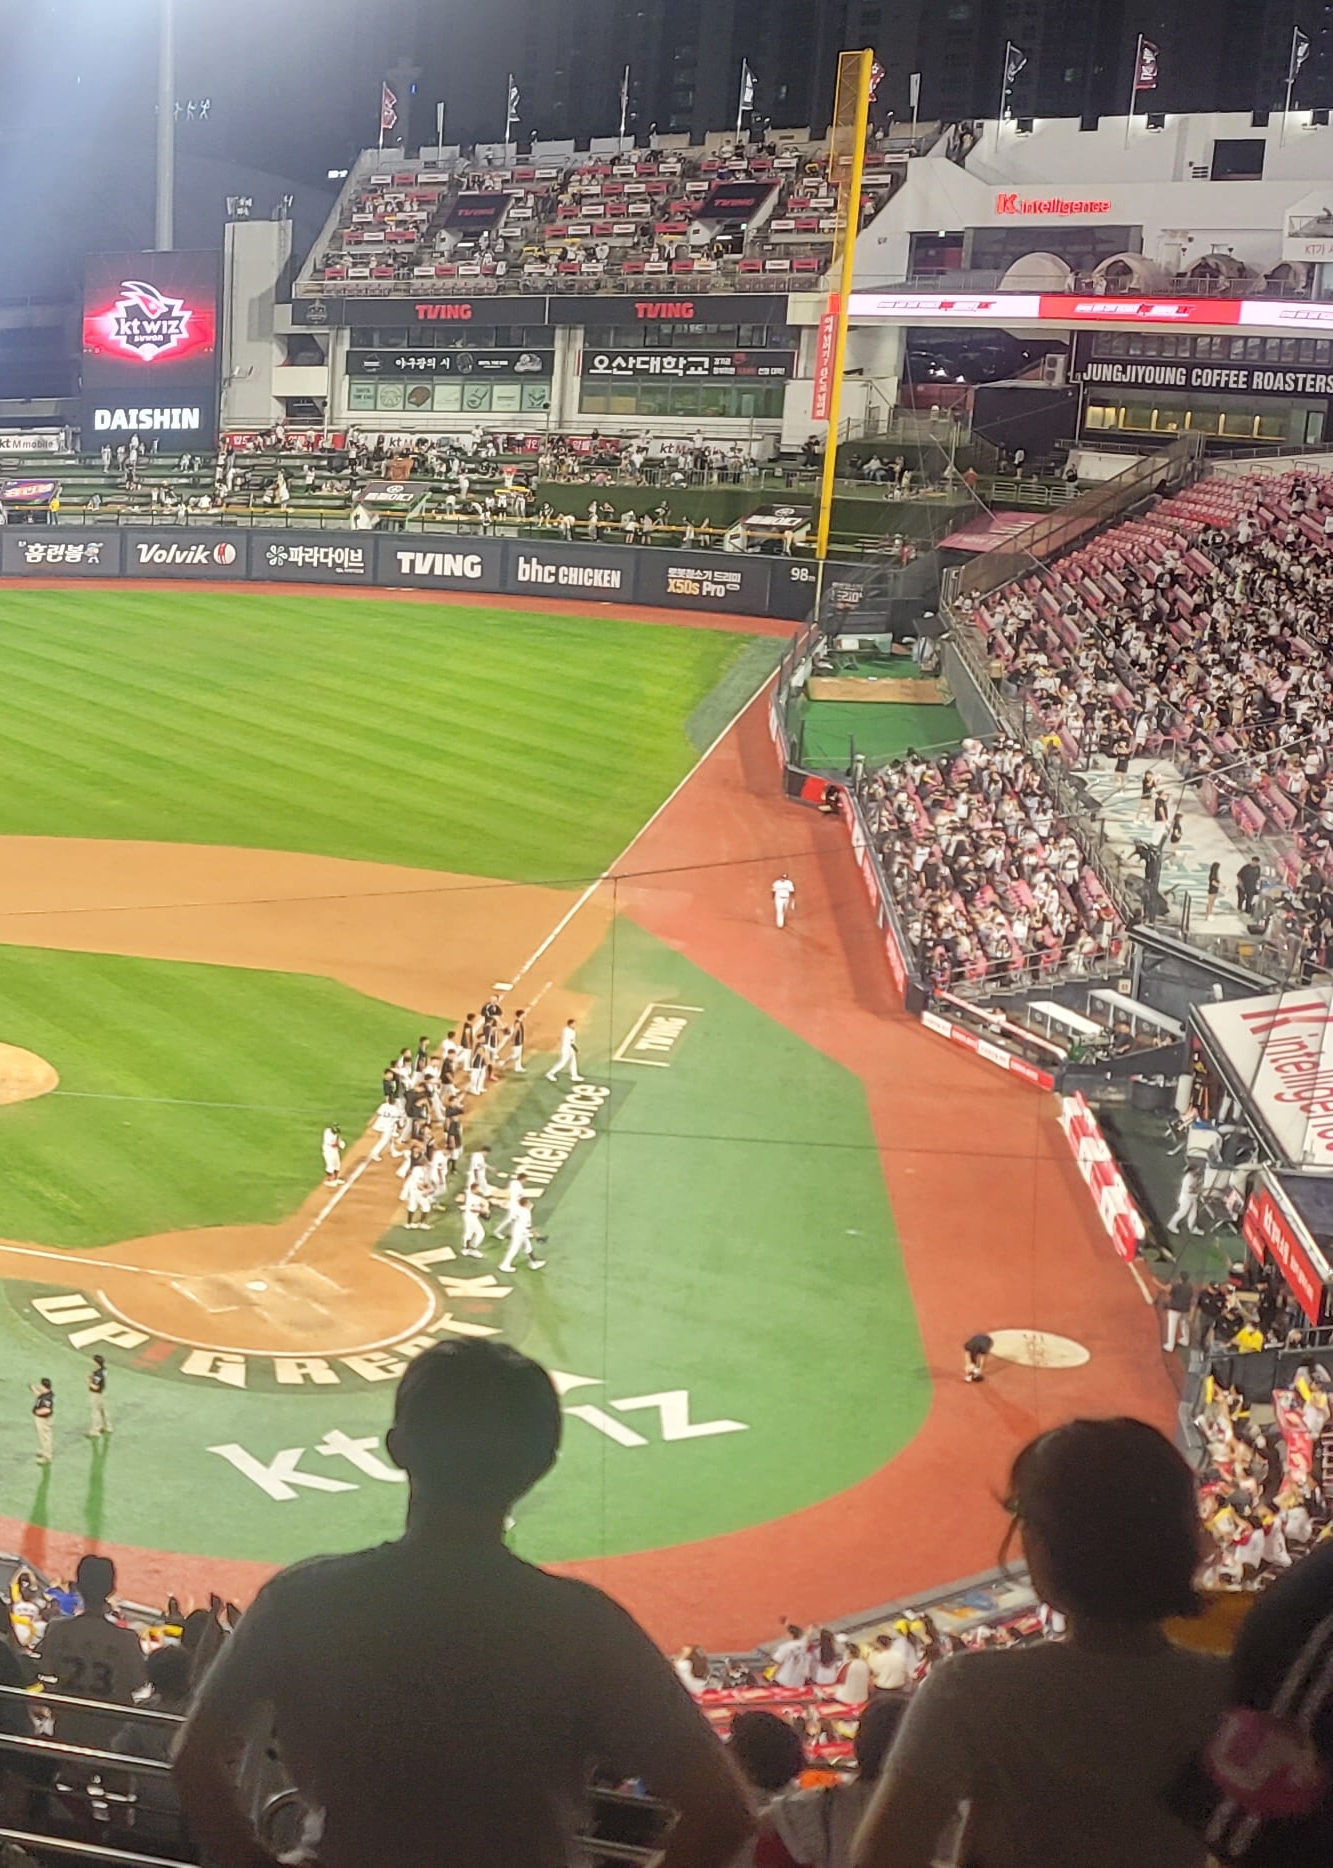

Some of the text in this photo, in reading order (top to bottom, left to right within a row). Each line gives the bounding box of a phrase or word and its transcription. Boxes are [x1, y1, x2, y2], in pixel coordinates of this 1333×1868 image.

[1020, 197, 1112, 216] intelligence
[416, 302, 473, 320] TVING
[635, 301, 695, 320] TVING
[120, 318, 181, 335] kt wiz
[395, 356, 451, 370] 야구광의 시
[589, 355, 710, 377] 오산대학교
[1082, 363, 1333, 394] JUNGJIYOUNG COFFEE ROASTERS
[94, 408, 200, 430] DAISHIN
[0, 437, 11, 448] kt
[22, 440, 54, 449] mobile
[24, 543, 85, 564] 홈런볼
[137, 543, 210, 565] Volvik
[288, 546, 364, 569] 파라다이브
[397, 551, 482, 578] TVING
[518, 556, 621, 589] bhc CHICKEN
[667, 567, 712, 580] 로봇청소기
[790, 567, 816, 582] 98m
[667, 578, 726, 598] X50s Pro
[633, 1015, 688, 1052] TVING
[1257, 1032, 1333, 1152] intelligen
[498, 1082, 612, 1185] intelligence
[382, 1245, 515, 1300] KT
[206, 1428, 408, 1502] kt
[60, 1655, 117, 1696] 23
